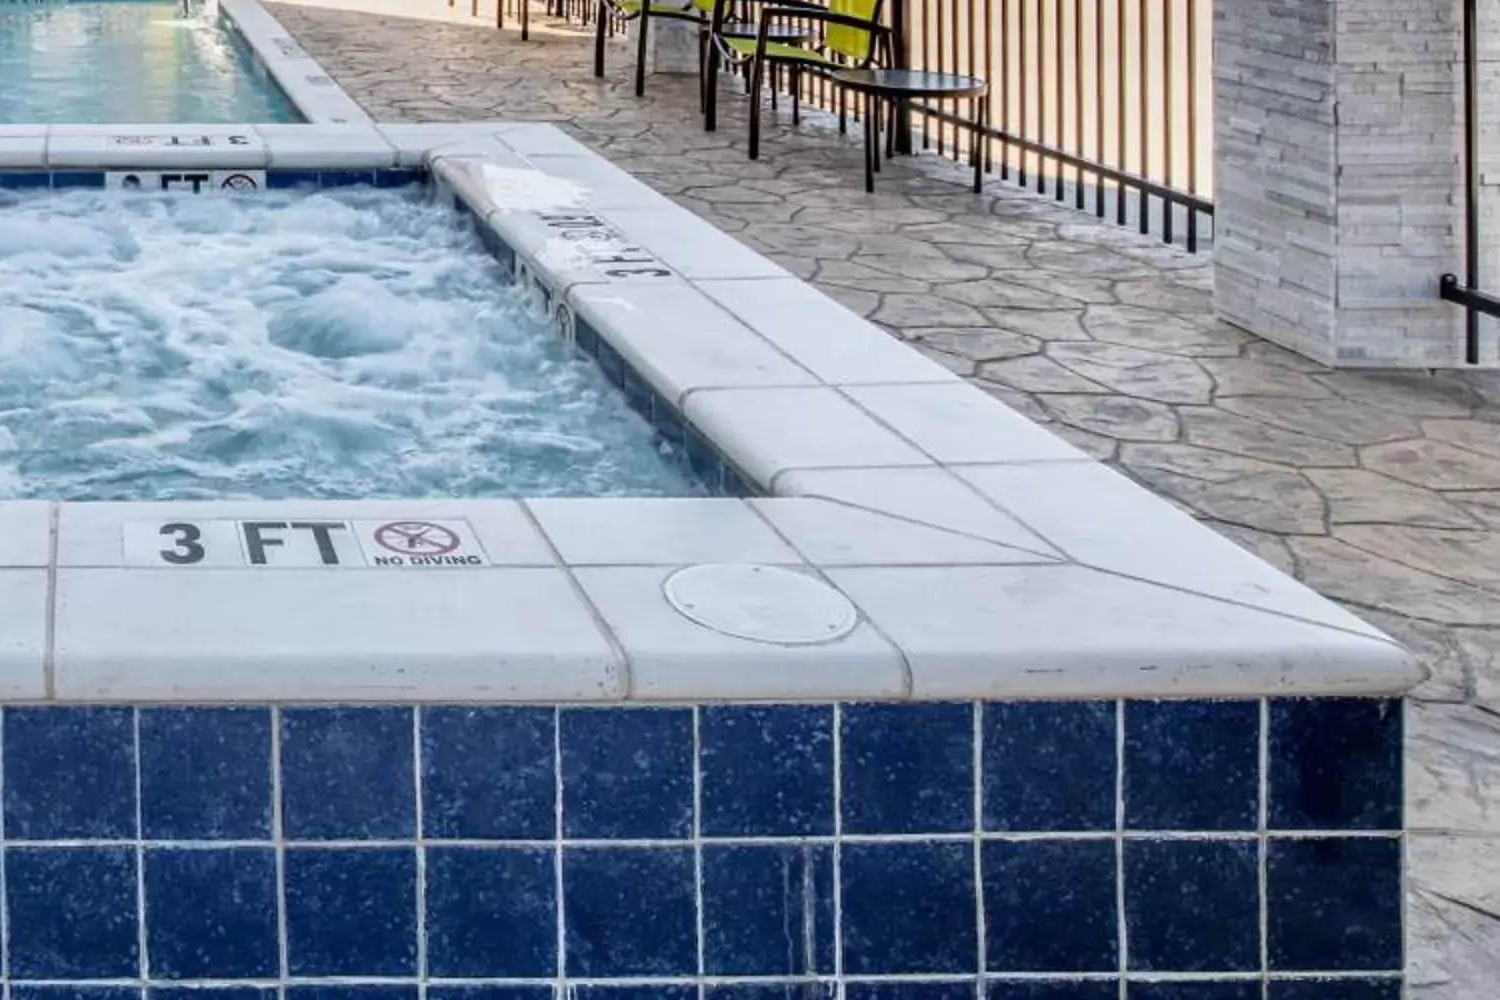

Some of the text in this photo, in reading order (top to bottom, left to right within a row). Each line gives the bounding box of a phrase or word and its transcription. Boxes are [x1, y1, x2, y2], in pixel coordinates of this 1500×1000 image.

[159, 522, 347, 565] 3 FT
[374, 555, 483, 565] NO DIVING
